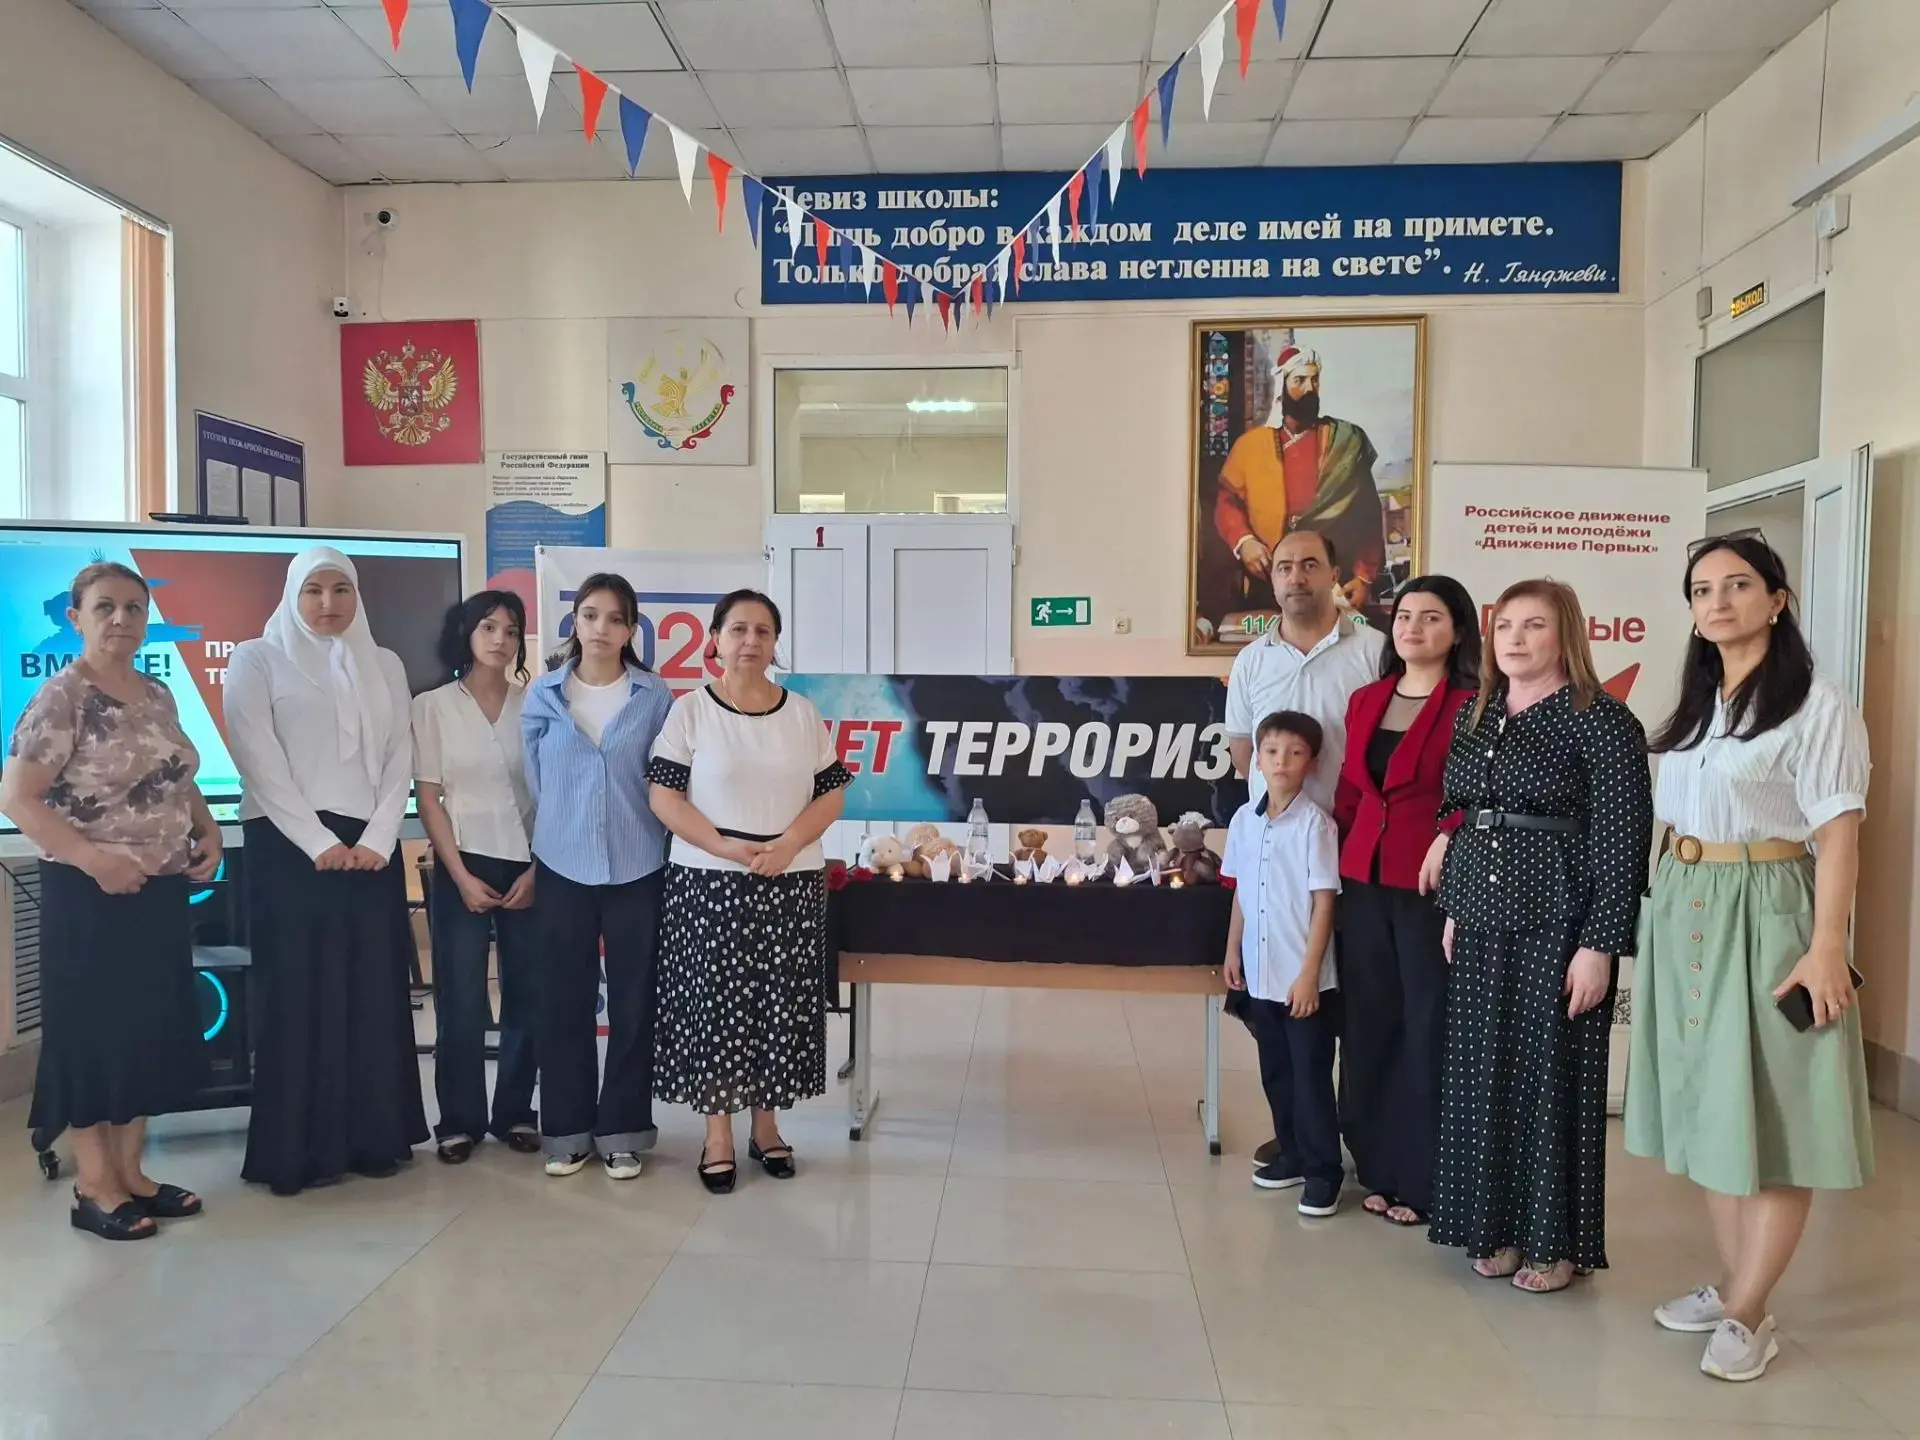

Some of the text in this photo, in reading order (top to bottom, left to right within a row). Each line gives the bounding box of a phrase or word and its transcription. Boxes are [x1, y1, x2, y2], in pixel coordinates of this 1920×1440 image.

[772, 185, 999, 216] Девиз школы:
[891, 218, 985, 251] добро
[996, 226, 1015, 245] в
[1173, 219, 1247, 244] деле
[1258, 212, 1342, 240] имей
[1353, 219, 1392, 239] на
[1404, 214, 1554, 242] примете.
[1019, 260, 1108, 282] слава
[1119, 257, 1270, 280] нетленна
[1282, 256, 1321, 277] на
[1332, 248, 1451, 277] свете”.
[1464, 505, 1671, 524] Российское движение
[815, 526, 824, 547] 1
[1484, 522, 1651, 538] детей и молодёжи
[1475, 536, 1658, 555] «Движение Первых»
[822, 719, 1245, 780] ЕТ ТЕРРОРИЗ
